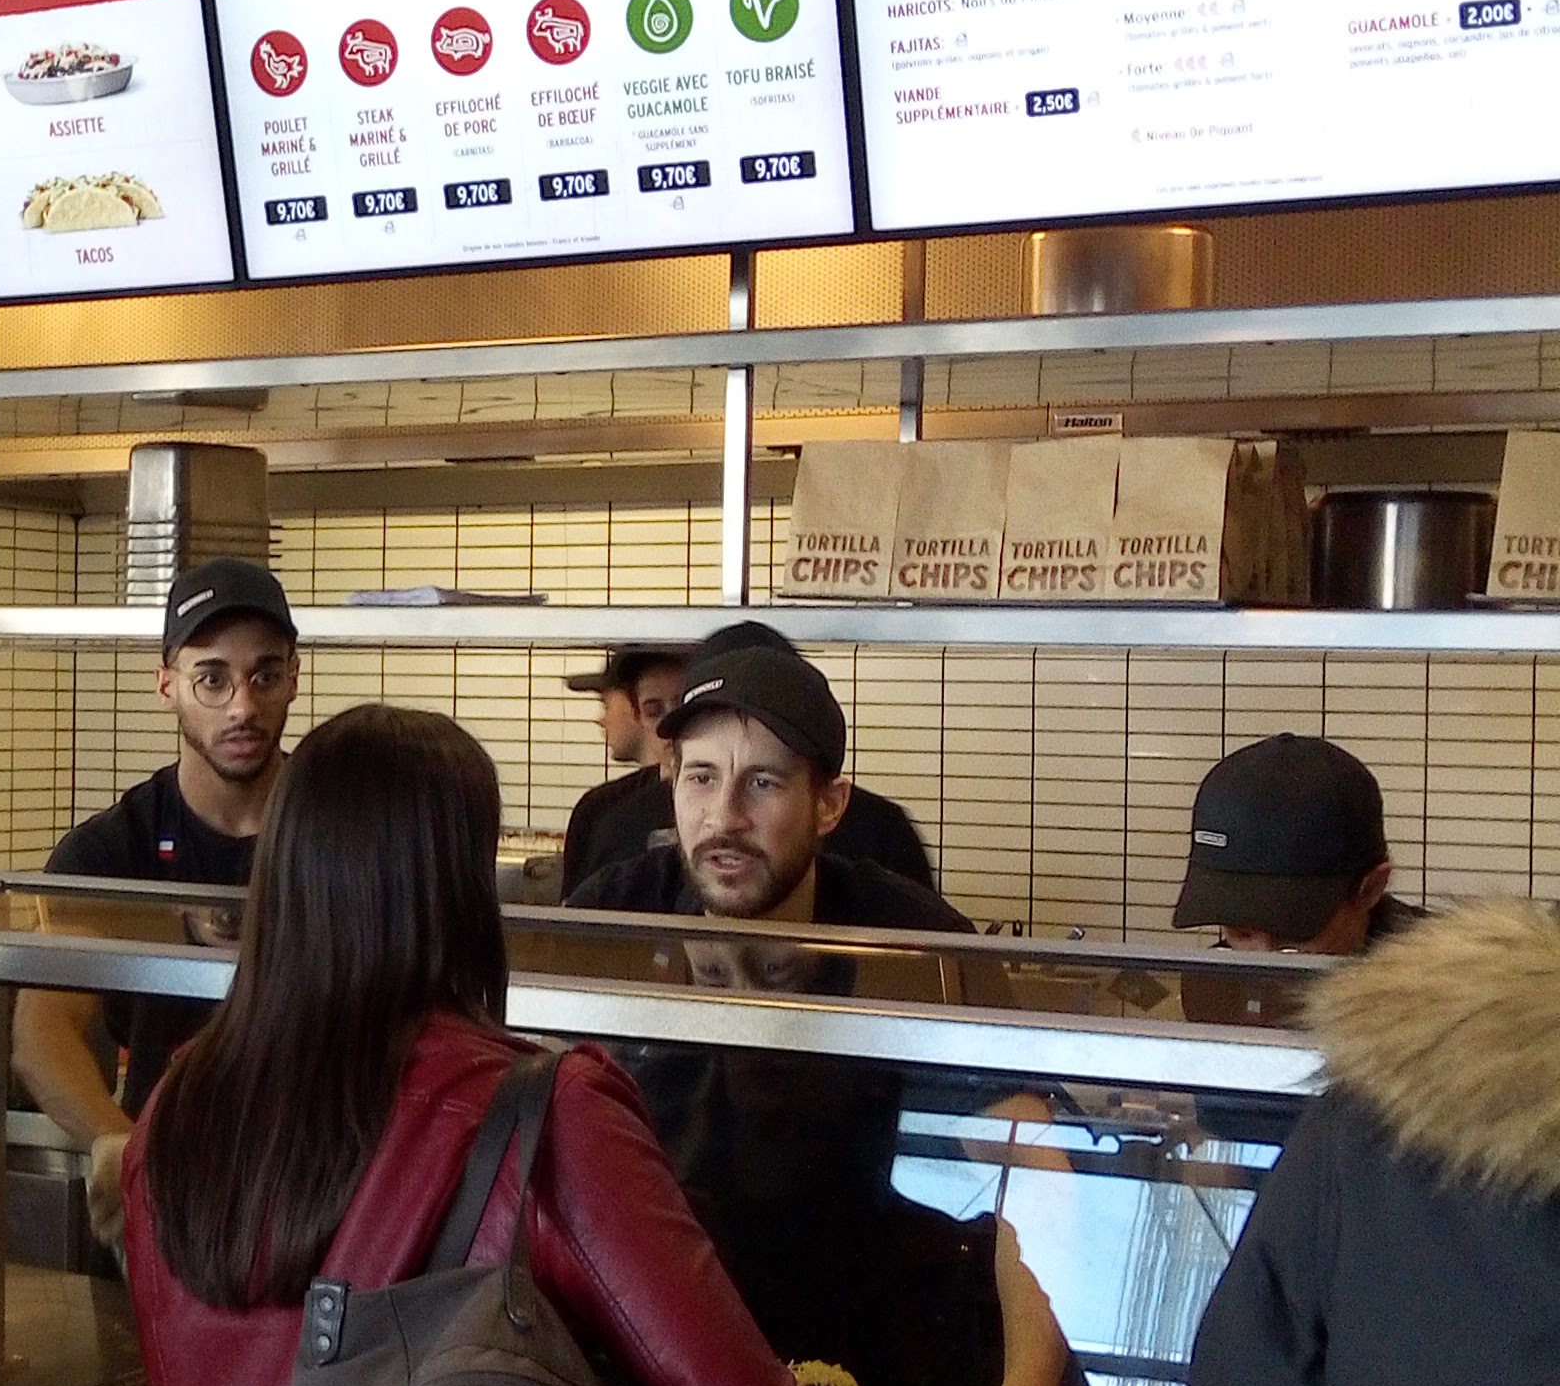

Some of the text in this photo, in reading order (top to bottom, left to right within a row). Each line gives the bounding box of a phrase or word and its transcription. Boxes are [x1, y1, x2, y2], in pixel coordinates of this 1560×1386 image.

[1349, 3, 1514, 35] GUACAMOLE 2,00€
[725, 58, 817, 86] TOFU BRAISÉ
[530, 81, 600, 106] EFFILOCHÉ
[624, 73, 709, 96] VEGGIE AVEC
[894, 87, 941, 104] VIANDE
[435, 93, 502, 117] EFFILOCHÉ
[627, 97, 709, 119] GUACAMOLE
[896, 93, 1074, 125] SUPPLÉMENTAIRE 2,50€
[49, 117, 105, 138] ASSIETTE
[264, 117, 308, 135] POULET
[357, 108, 394, 126] STEAK
[444, 118, 497, 138] DE PORC
[538, 113, 553, 128] DE
[261, 135, 317, 156] MARINÉ &
[349, 127, 407, 147] MARINÉ &
[271, 155, 311, 177] GRILLÉ
[359, 147, 401, 168] GRILLÉ
[754, 156, 801, 180] 9,70€
[552, 173, 596, 198] 9,70€
[651, 164, 697, 188] 9,70€
[365, 191, 405, 214] 9,70€
[456, 183, 498, 207] 9,70€
[276, 199, 316, 221] 9,70€
[75, 247, 114, 265] TACOS
[796, 533, 879, 553] TORTILLA
[903, 538, 989, 557] TORTILLA
[1011, 539, 1098, 560] TORTILLA
[1118, 535, 1208, 555] TORTILLA
[1504, 535, 1560, 556] TORT
[791, 556, 880, 586] CHIPS
[898, 562, 989, 590] CHIPS
[1007, 563, 1097, 592] CHIPS
[1113, 559, 1207, 590] CHIPS
